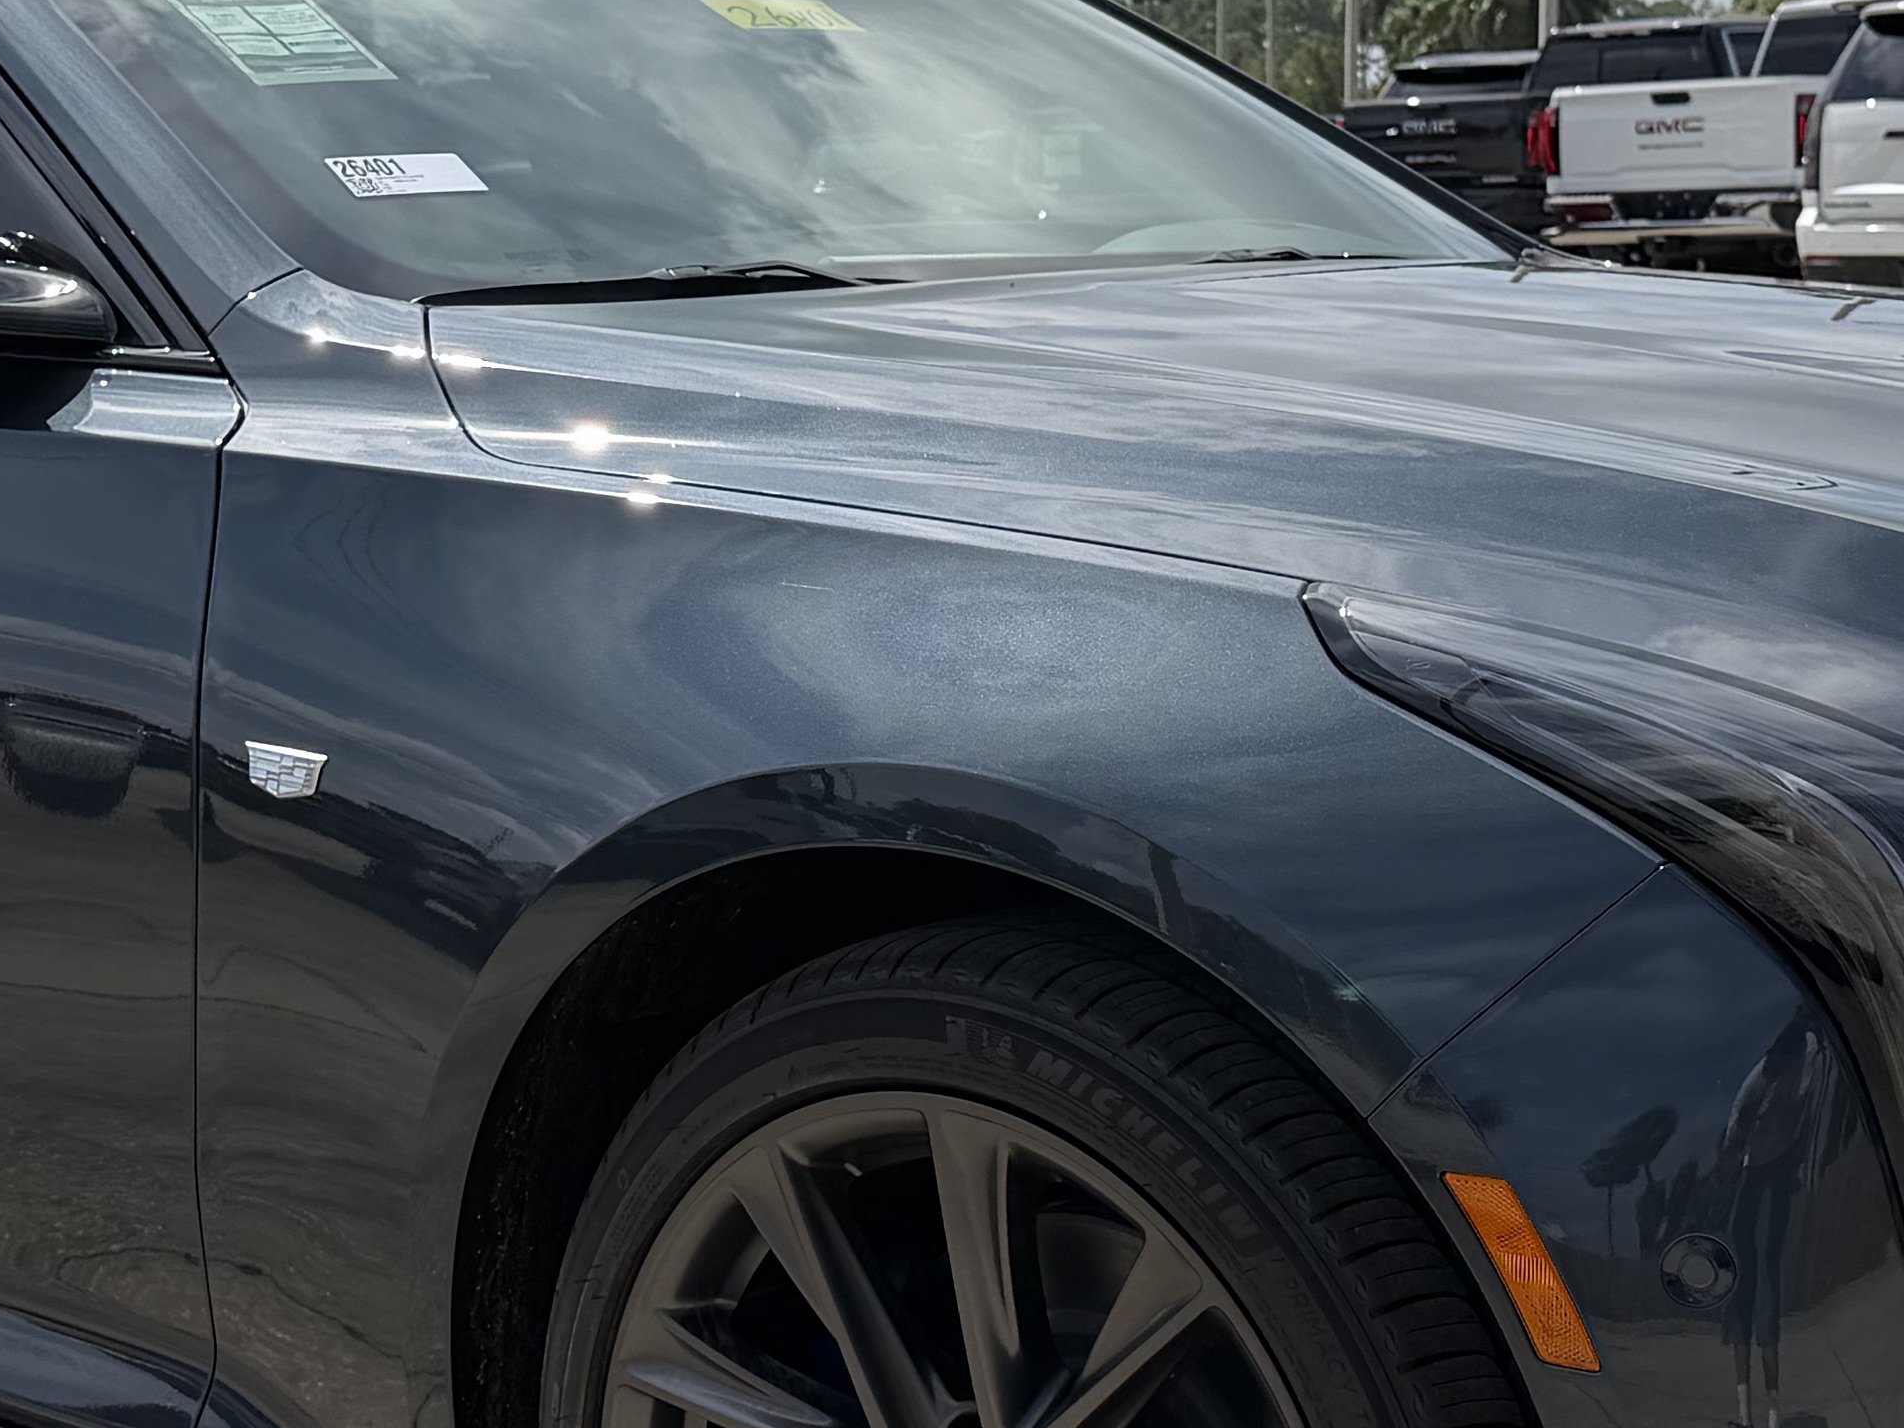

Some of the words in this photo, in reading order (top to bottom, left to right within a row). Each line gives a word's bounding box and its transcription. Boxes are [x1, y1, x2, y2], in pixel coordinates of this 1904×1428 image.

[1635, 116, 1705, 134] GMC
[332, 158, 406, 178] 26401
[1025, 1048, 1263, 1241] MICHELIN
[1282, 1274, 1359, 1397] PRIMACY
